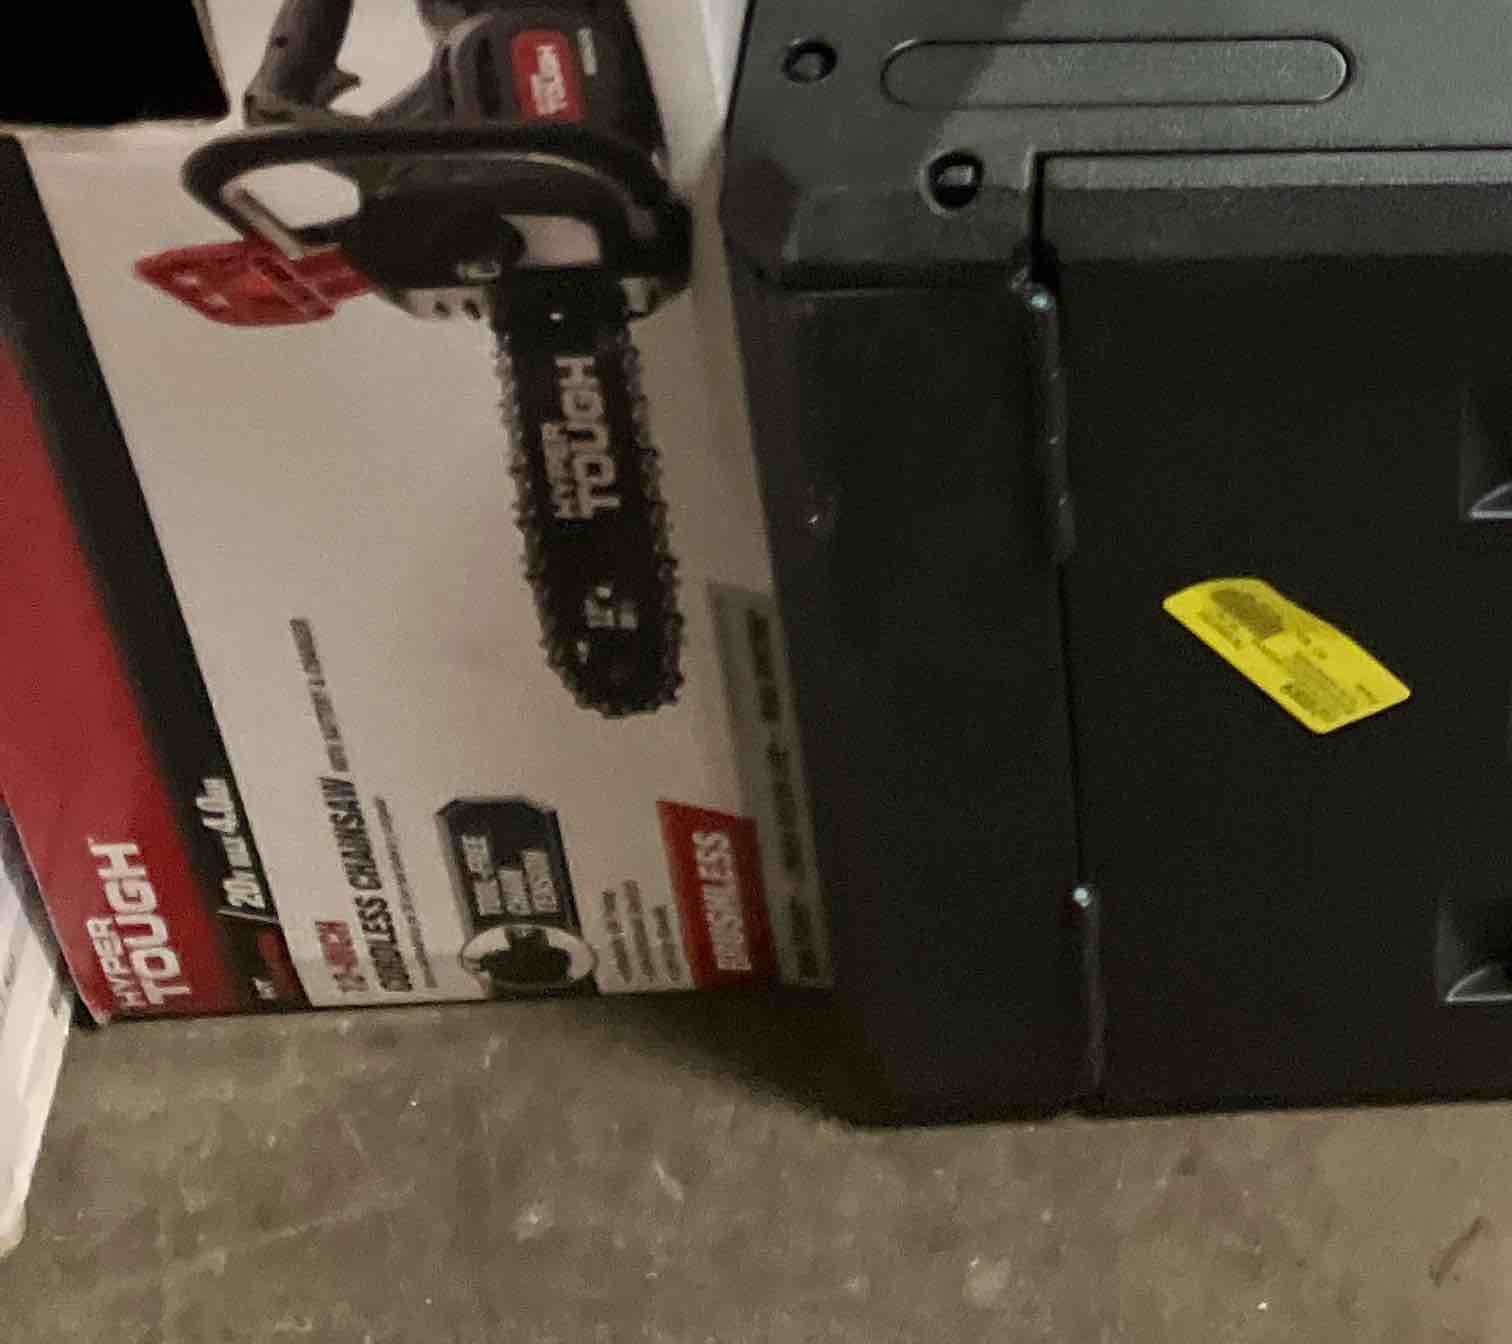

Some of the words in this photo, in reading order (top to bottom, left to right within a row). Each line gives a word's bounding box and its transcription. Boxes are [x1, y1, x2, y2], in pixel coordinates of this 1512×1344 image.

[557, 356, 621, 515] TOUGH
[318, 776, 383, 891] CHAINSAW
[86, 916, 151, 1009] HYPER
[89, 841, 192, 1005] TOUGH
